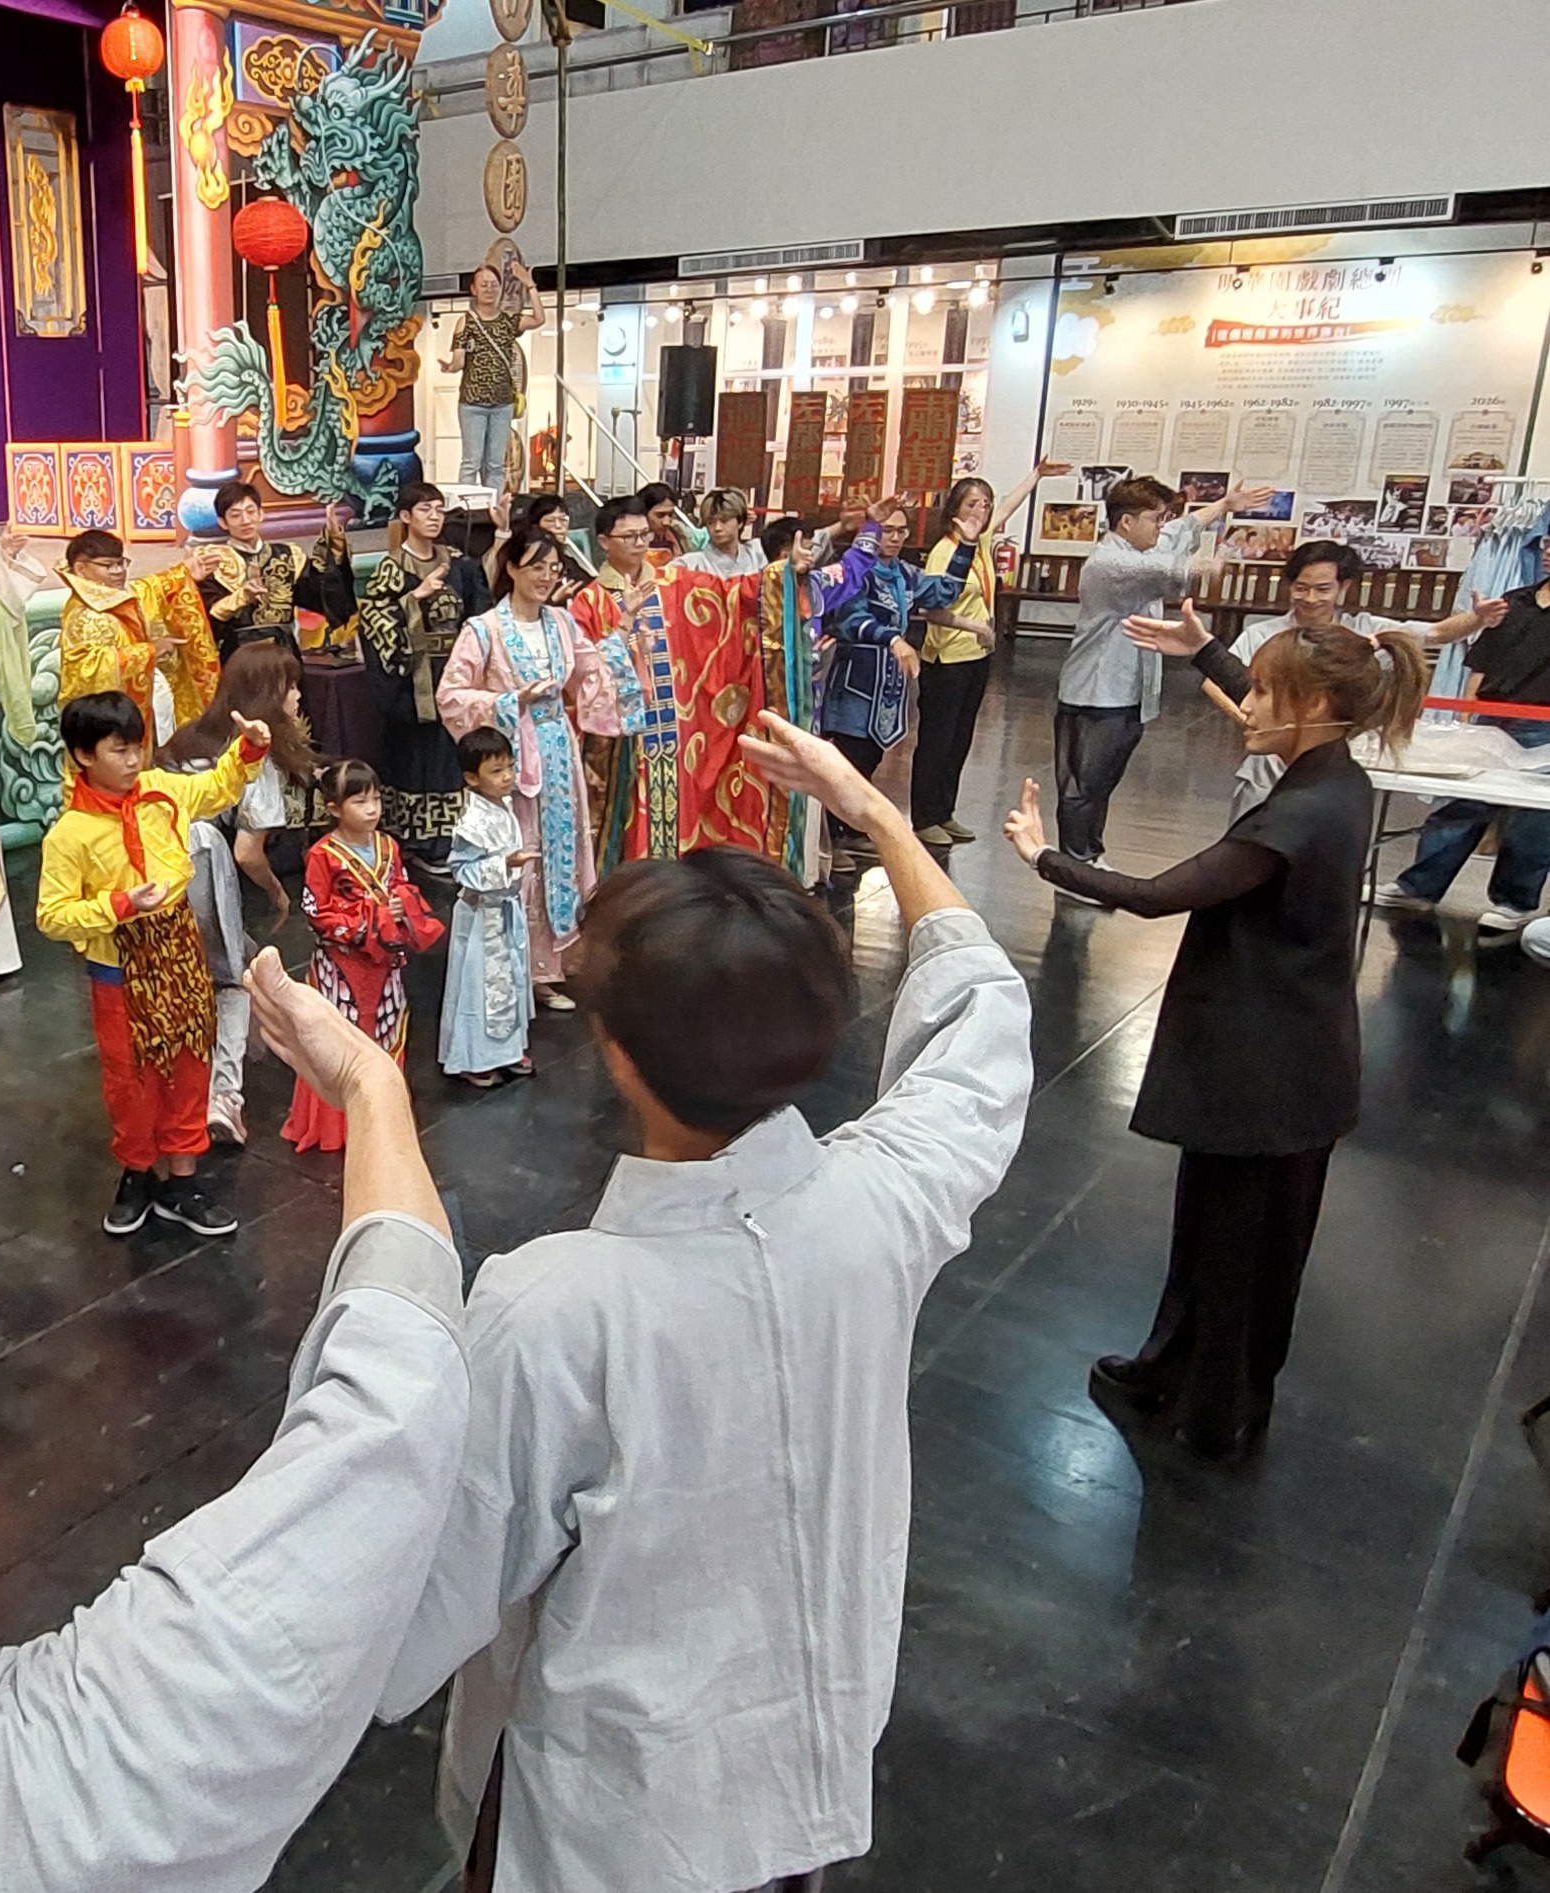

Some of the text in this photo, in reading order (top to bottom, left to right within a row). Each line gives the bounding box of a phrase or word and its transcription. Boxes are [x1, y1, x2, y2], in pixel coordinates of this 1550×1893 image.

[1267, 296, 1340, 320] 大事紀
[901, 389, 956, 489] 肅靜
